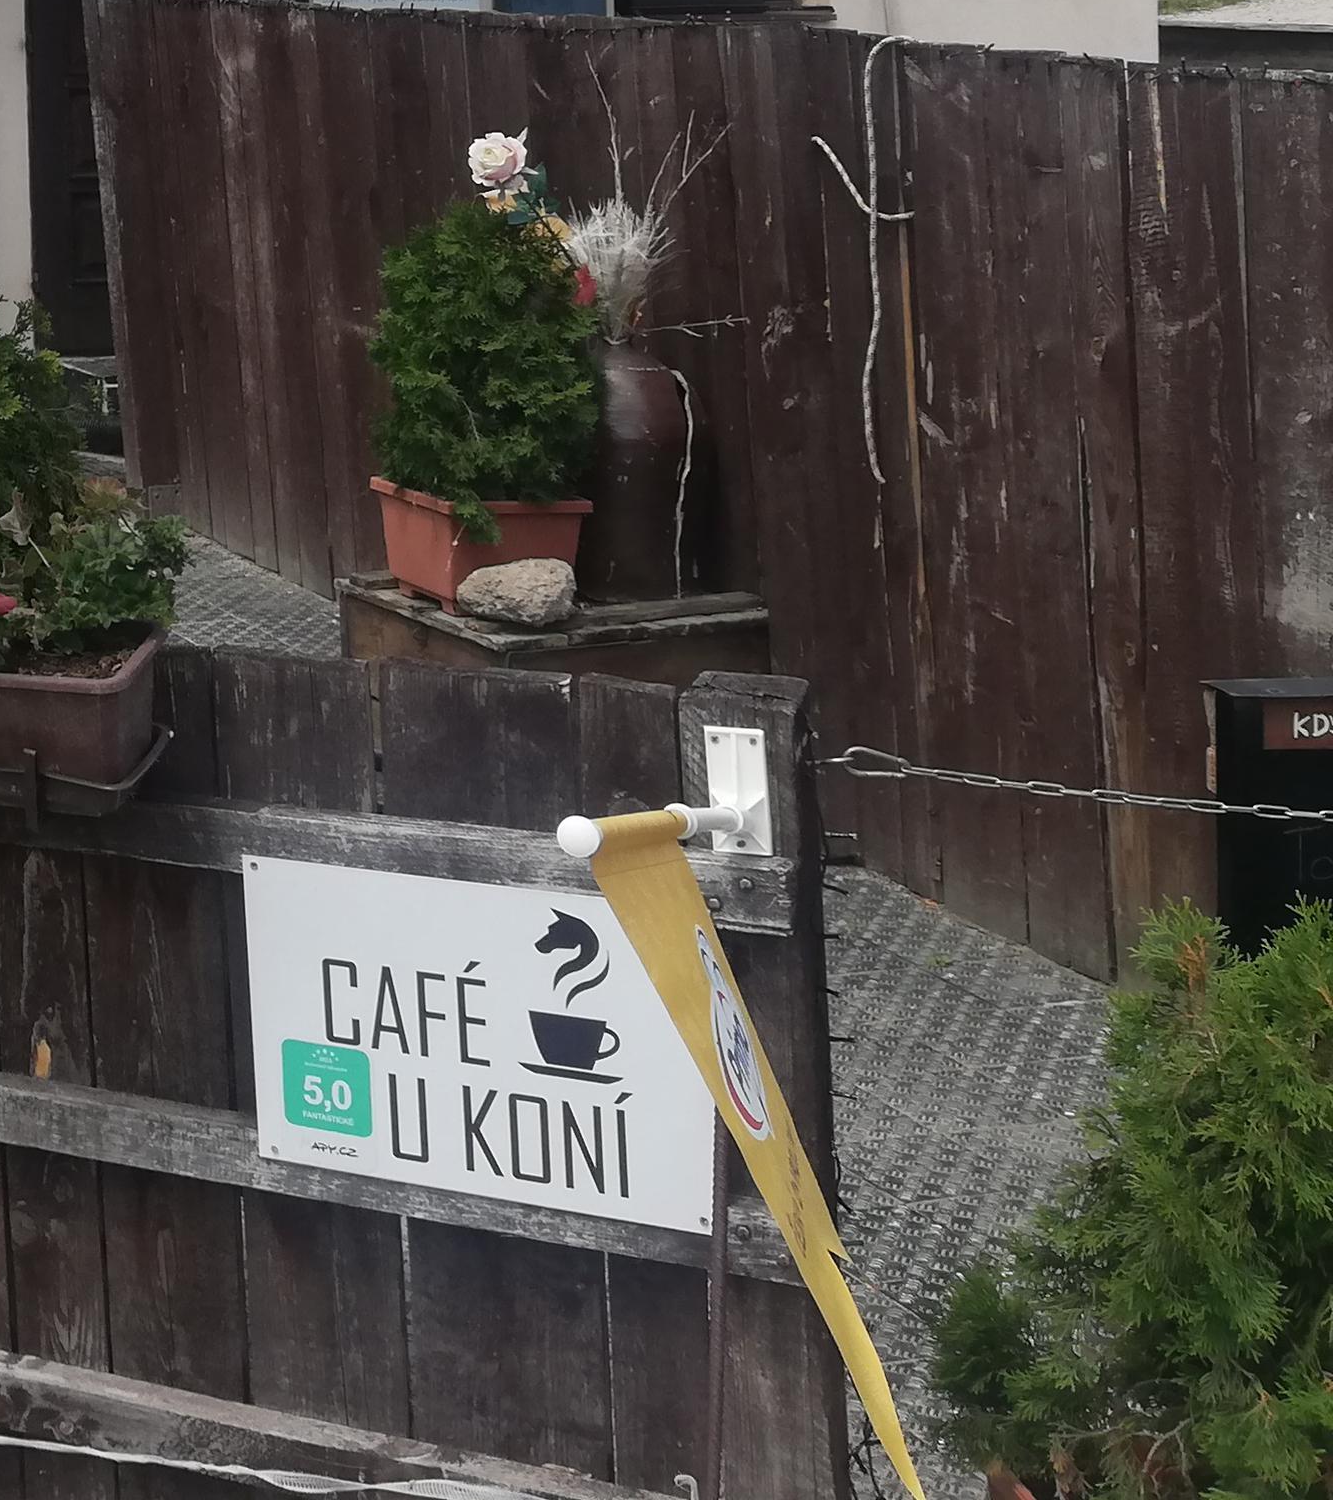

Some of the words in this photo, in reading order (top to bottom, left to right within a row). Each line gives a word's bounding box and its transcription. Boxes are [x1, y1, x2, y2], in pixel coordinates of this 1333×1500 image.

[1293, 711, 1333, 739] KD
[322, 958, 491, 1067] CAFÉ
[302, 1075, 352, 1113] 5,0
[388, 1073, 429, 1163] U
[462, 1085, 633, 1199] KONÍ
